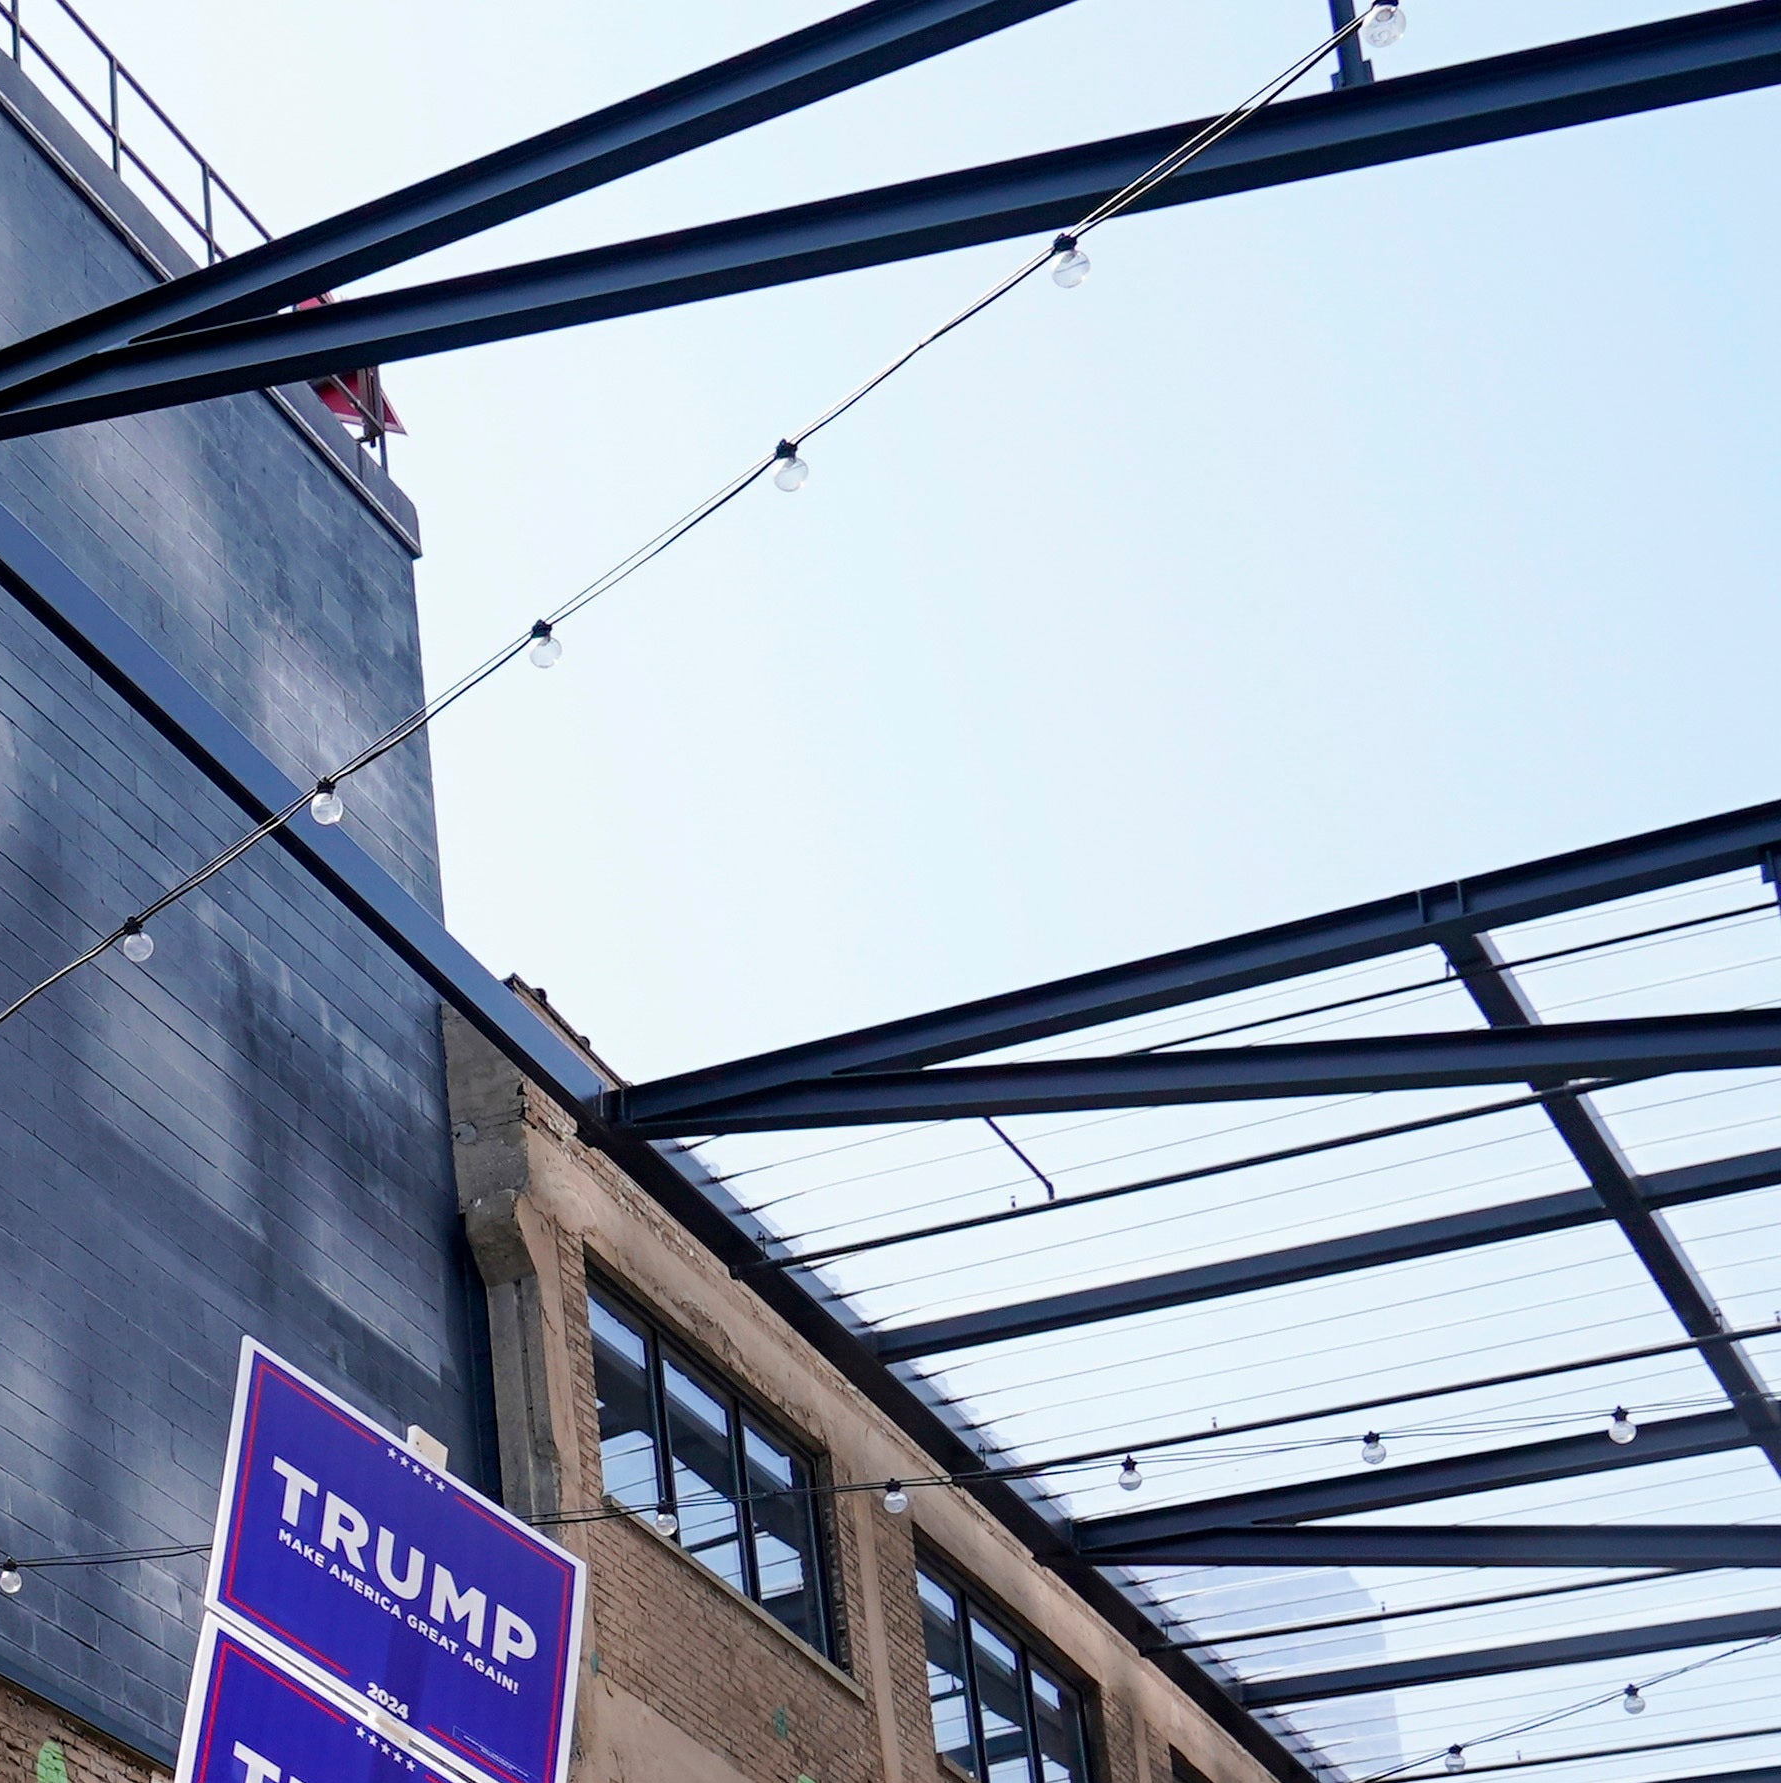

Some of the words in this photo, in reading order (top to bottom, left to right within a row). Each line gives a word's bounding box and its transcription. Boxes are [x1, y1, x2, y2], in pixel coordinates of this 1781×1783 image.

[272, 1454, 538, 1666] TRUMP
[277, 1527, 325, 1569] MAKE
[328, 1563, 403, 1620] AMERICA
[406, 1613, 460, 1656] GREAT
[462, 1650, 521, 1696] AGAIN!
[366, 1681, 411, 1721] 2024
